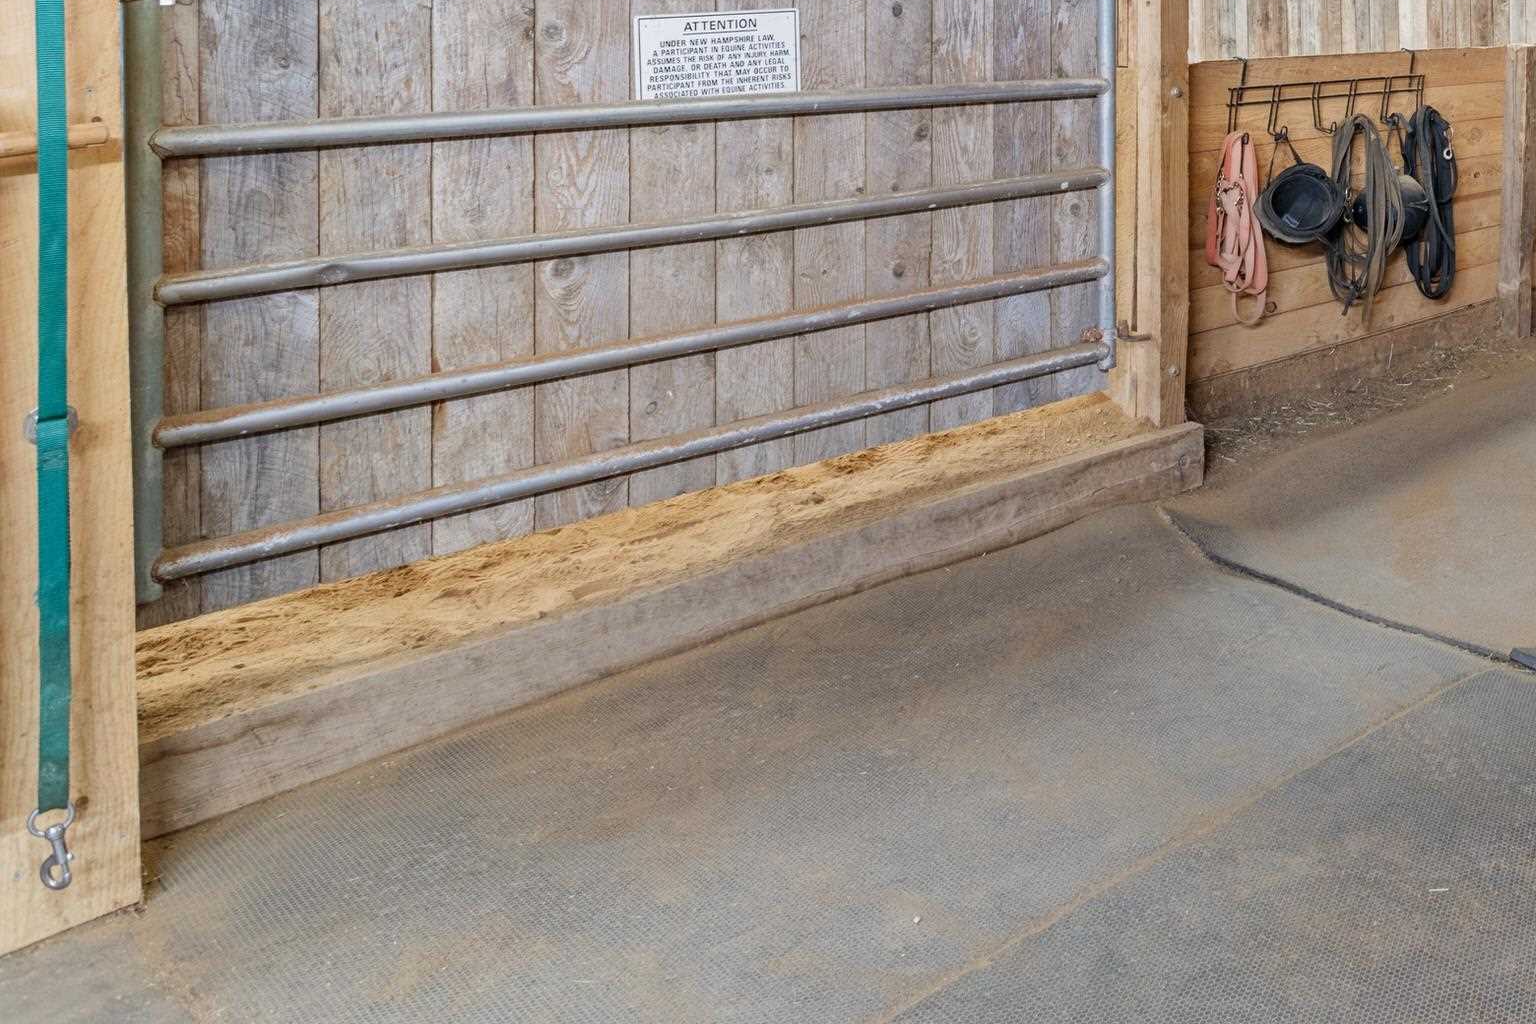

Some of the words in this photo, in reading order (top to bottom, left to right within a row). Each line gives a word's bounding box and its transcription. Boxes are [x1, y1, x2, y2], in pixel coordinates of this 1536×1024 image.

[684, 18, 757, 31] ATTENTION
[660, 40, 686, 48] UNDER
[690, 38, 707, 46] NEW
[711, 35, 754, 45] HAMPSHIRE
[661, 46, 707, 56] PARTICIPANT
[711, 45, 719, 53] IN
[722, 43, 745, 53] EQUINE
[748, 41, 785, 51] ACTIVITIES
[648, 57, 681, 66] ASSUMES
[699, 55, 714, 63] RISK
[717, 53, 725, 61] OF
[728, 52, 741, 60] ANY
[691, 63, 701, 72] OR
[704, 61, 726, 70] DEATH
[730, 60, 745, 68] AND
[748, 58, 761, 67] ANY
[765, 56, 785, 66] LEGAL
[650, 71, 710, 83] RESPONSIBILITY
[714, 69, 731, 78] THAT
[736, 68, 750, 76] MAY
[754, 65, 777, 75] OCCUR
[781, 64, 790, 72] TO
[648, 80, 694, 91] PARTICIPANT
[698, 78, 718, 87] FROM
[722, 77, 733, 85] THE
[737, 74, 769, 84] INHERENT
[772, 72, 792, 81] RISKS
[654, 88, 698, 99] ASSOCIATED
[702, 86, 719, 96] WITH
[722, 84, 745, 94] EQUINE
[749, 81, 785, 91] ACTIVITIES
